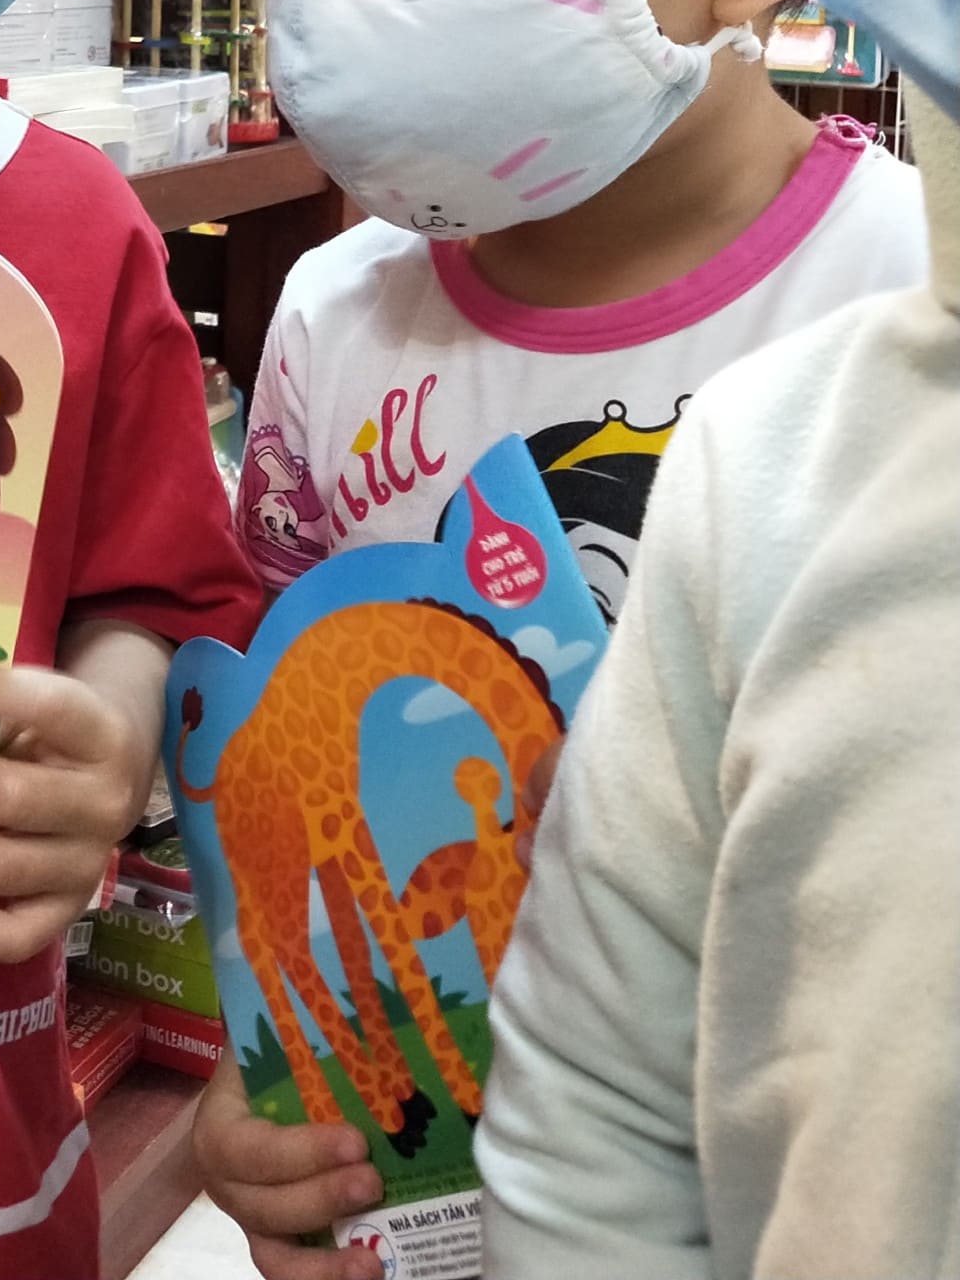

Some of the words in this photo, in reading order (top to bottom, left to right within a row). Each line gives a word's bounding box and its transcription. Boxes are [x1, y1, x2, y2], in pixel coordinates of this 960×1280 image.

[136, 962, 183, 997] box
[165, 1026, 217, 1060] LEARNING
[388, 1212, 413, 1232] NHÀ
[413, 1209, 442, 1228] SÁCH
[441, 1202, 466, 1222] TÂN
